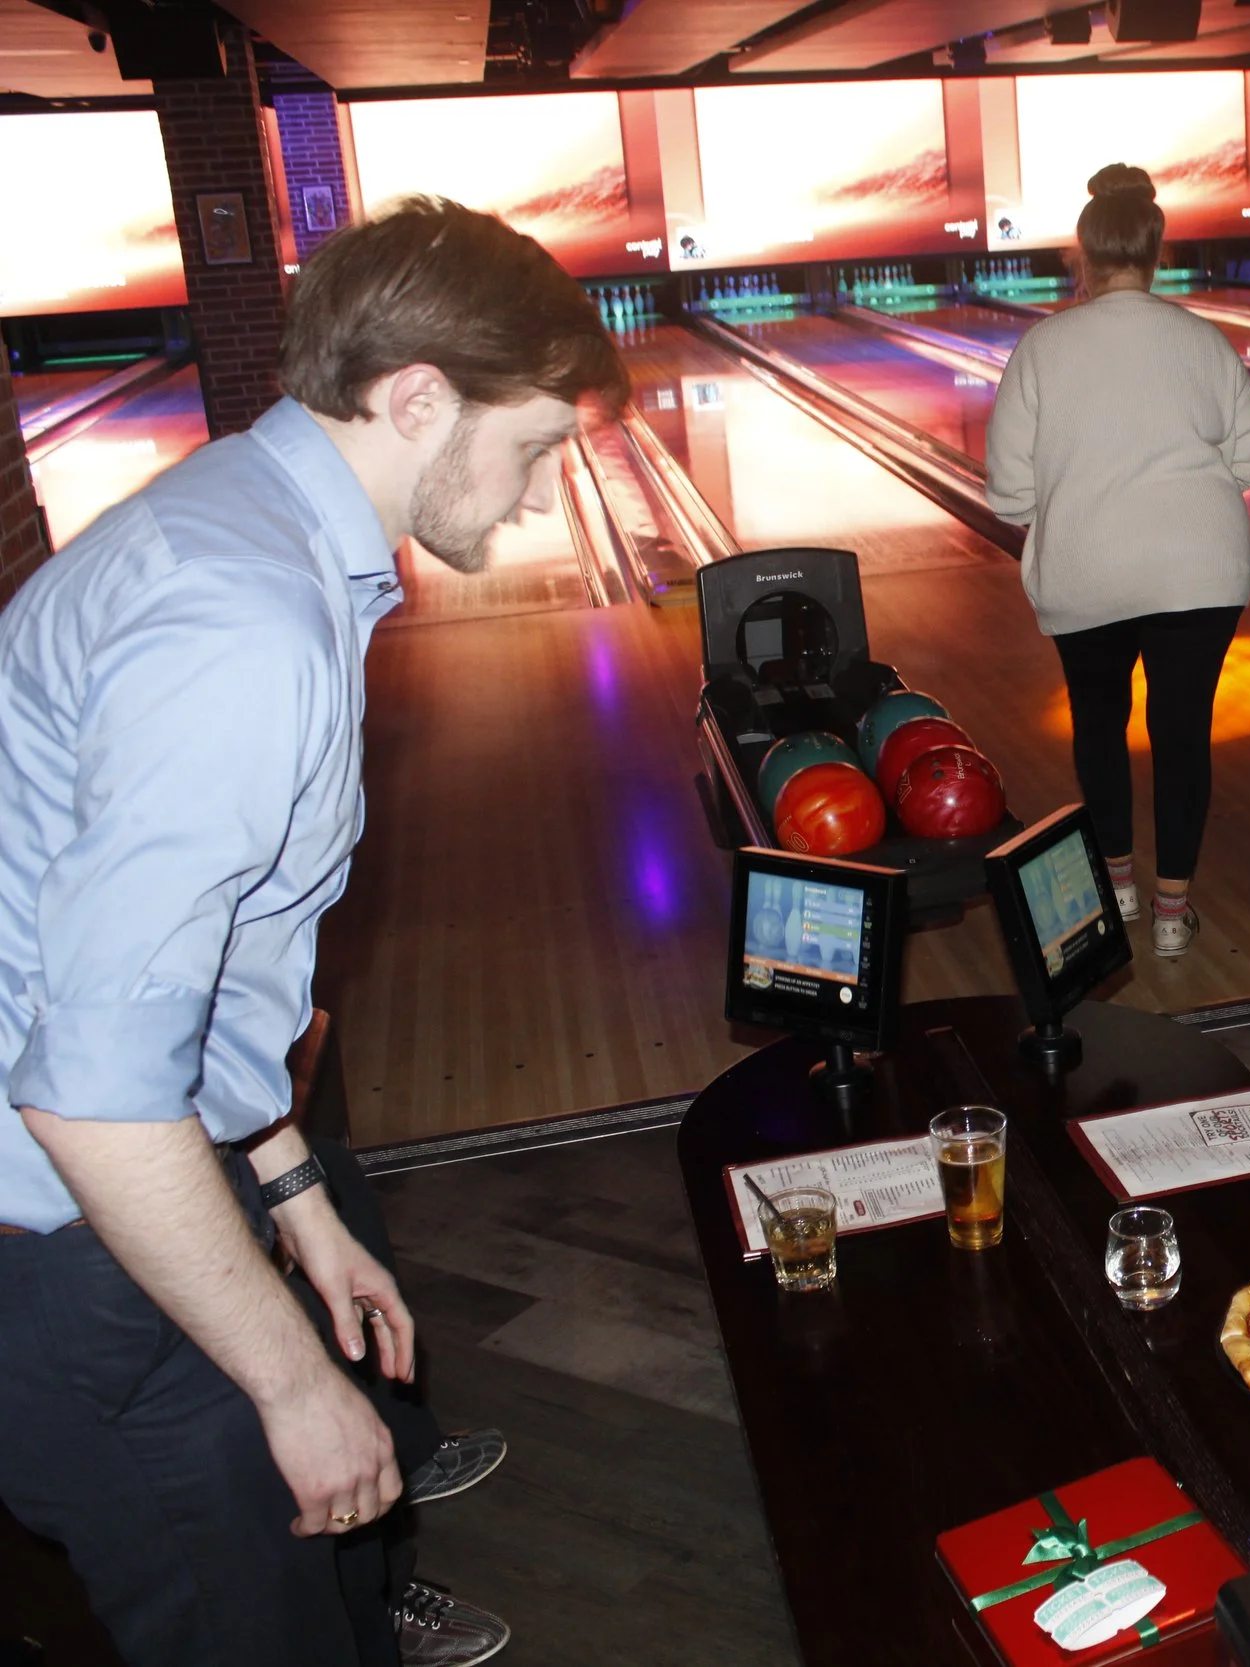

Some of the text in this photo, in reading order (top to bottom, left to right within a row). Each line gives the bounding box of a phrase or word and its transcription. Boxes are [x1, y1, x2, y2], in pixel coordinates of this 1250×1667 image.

[756, 570, 803, 582] Brunswick
[1197, 1115, 1215, 1141] TRY ONE
[1211, 1109, 1238, 1141] SPORTS
